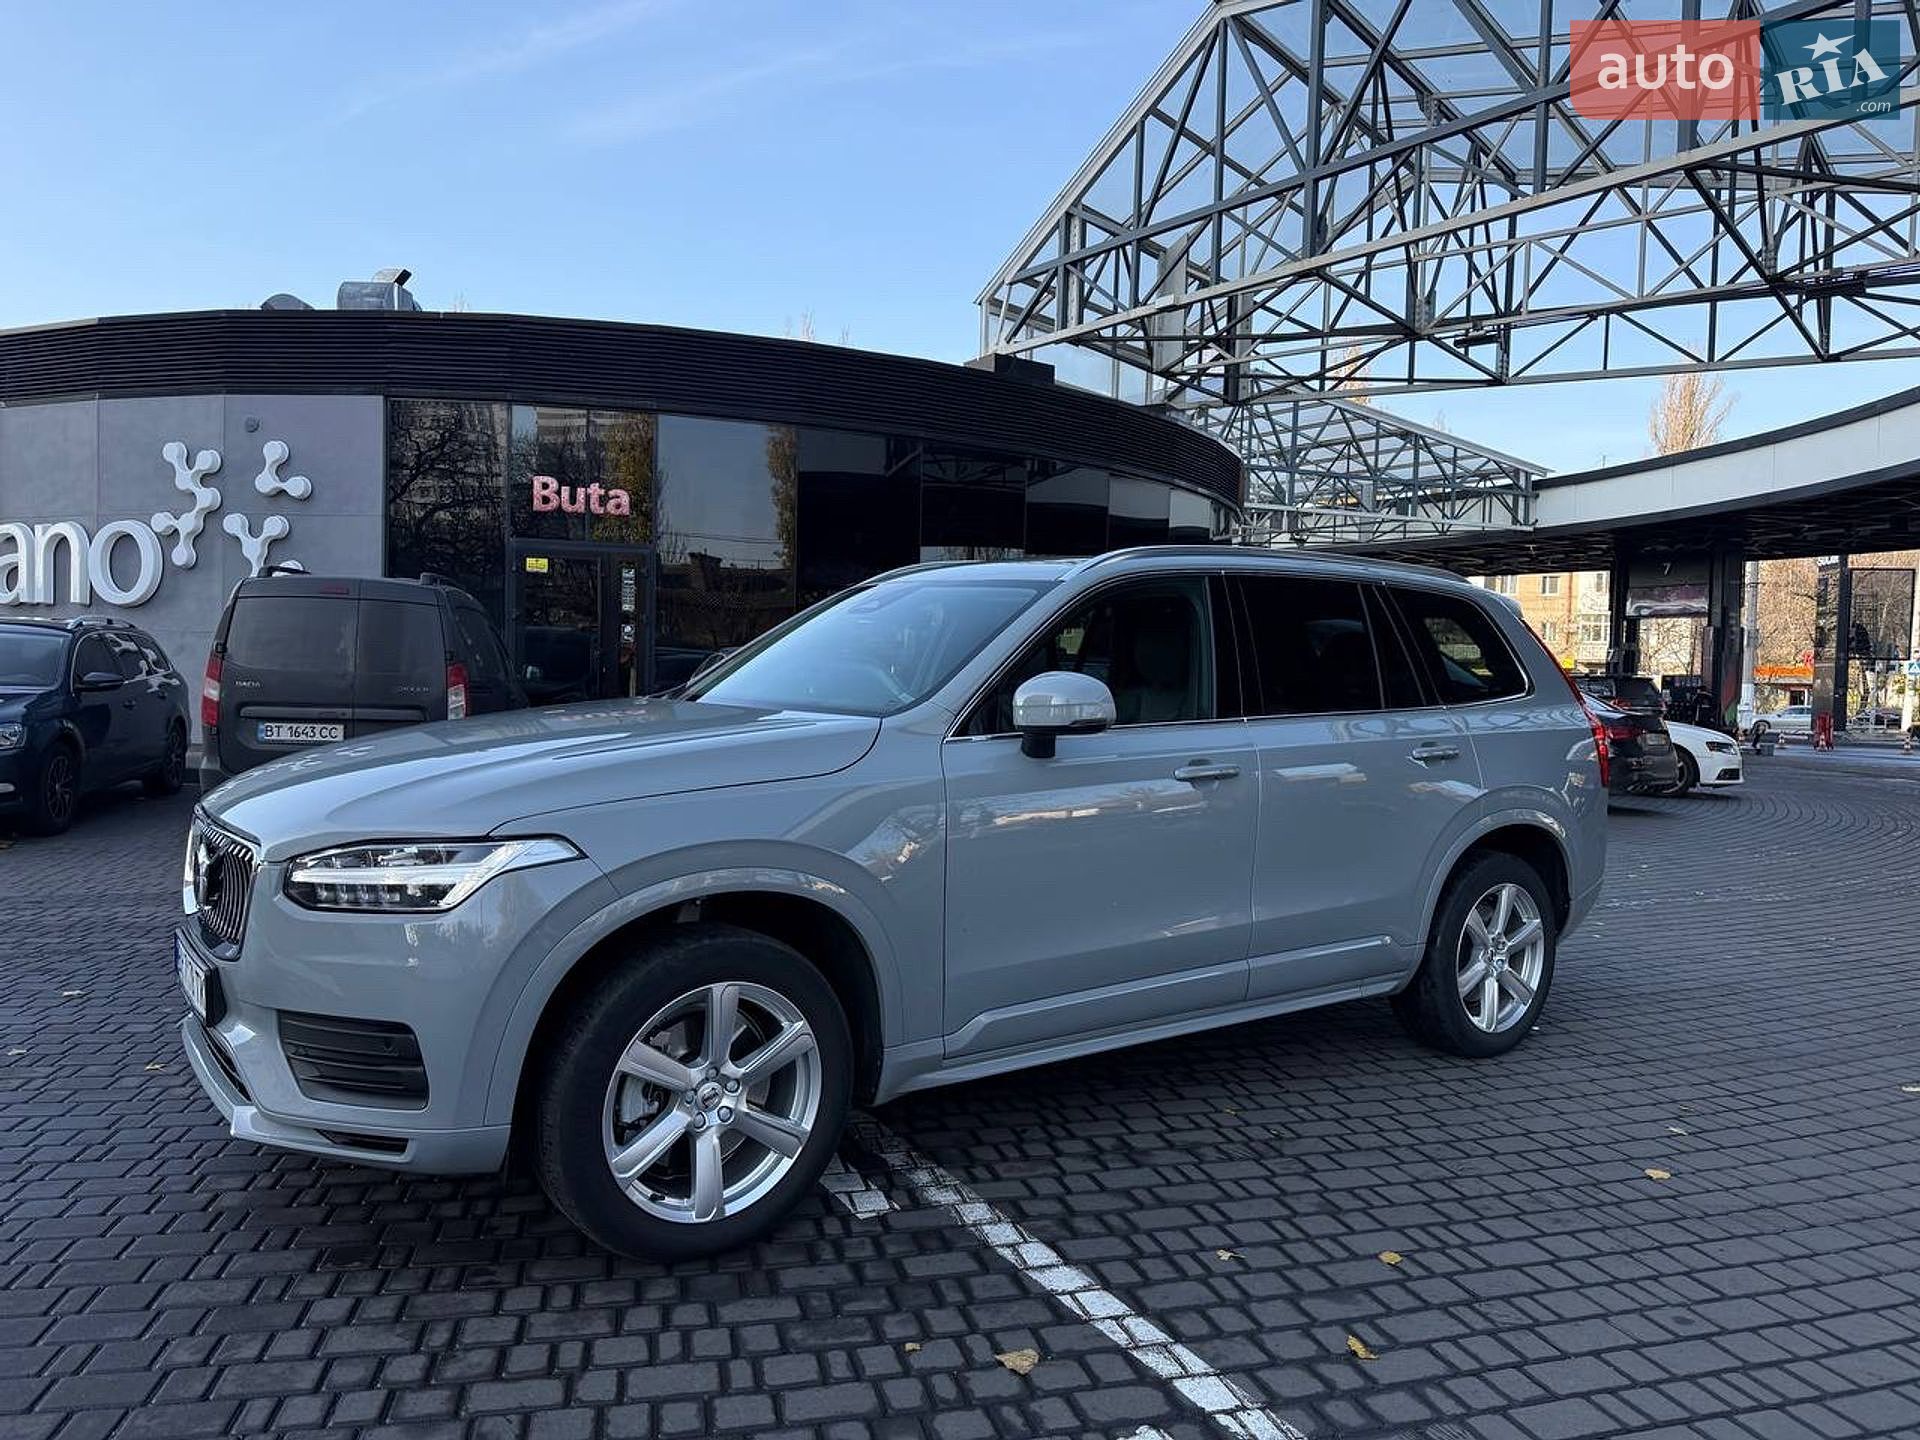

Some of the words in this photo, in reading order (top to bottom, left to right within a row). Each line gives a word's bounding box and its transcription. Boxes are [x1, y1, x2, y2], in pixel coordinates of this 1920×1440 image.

[532, 475, 630, 516] Buta
[1663, 562, 1671, 576] 7
[265, 724, 283, 738] BT
[287, 725, 316, 738] 1643
[320, 726, 338, 739] CC
